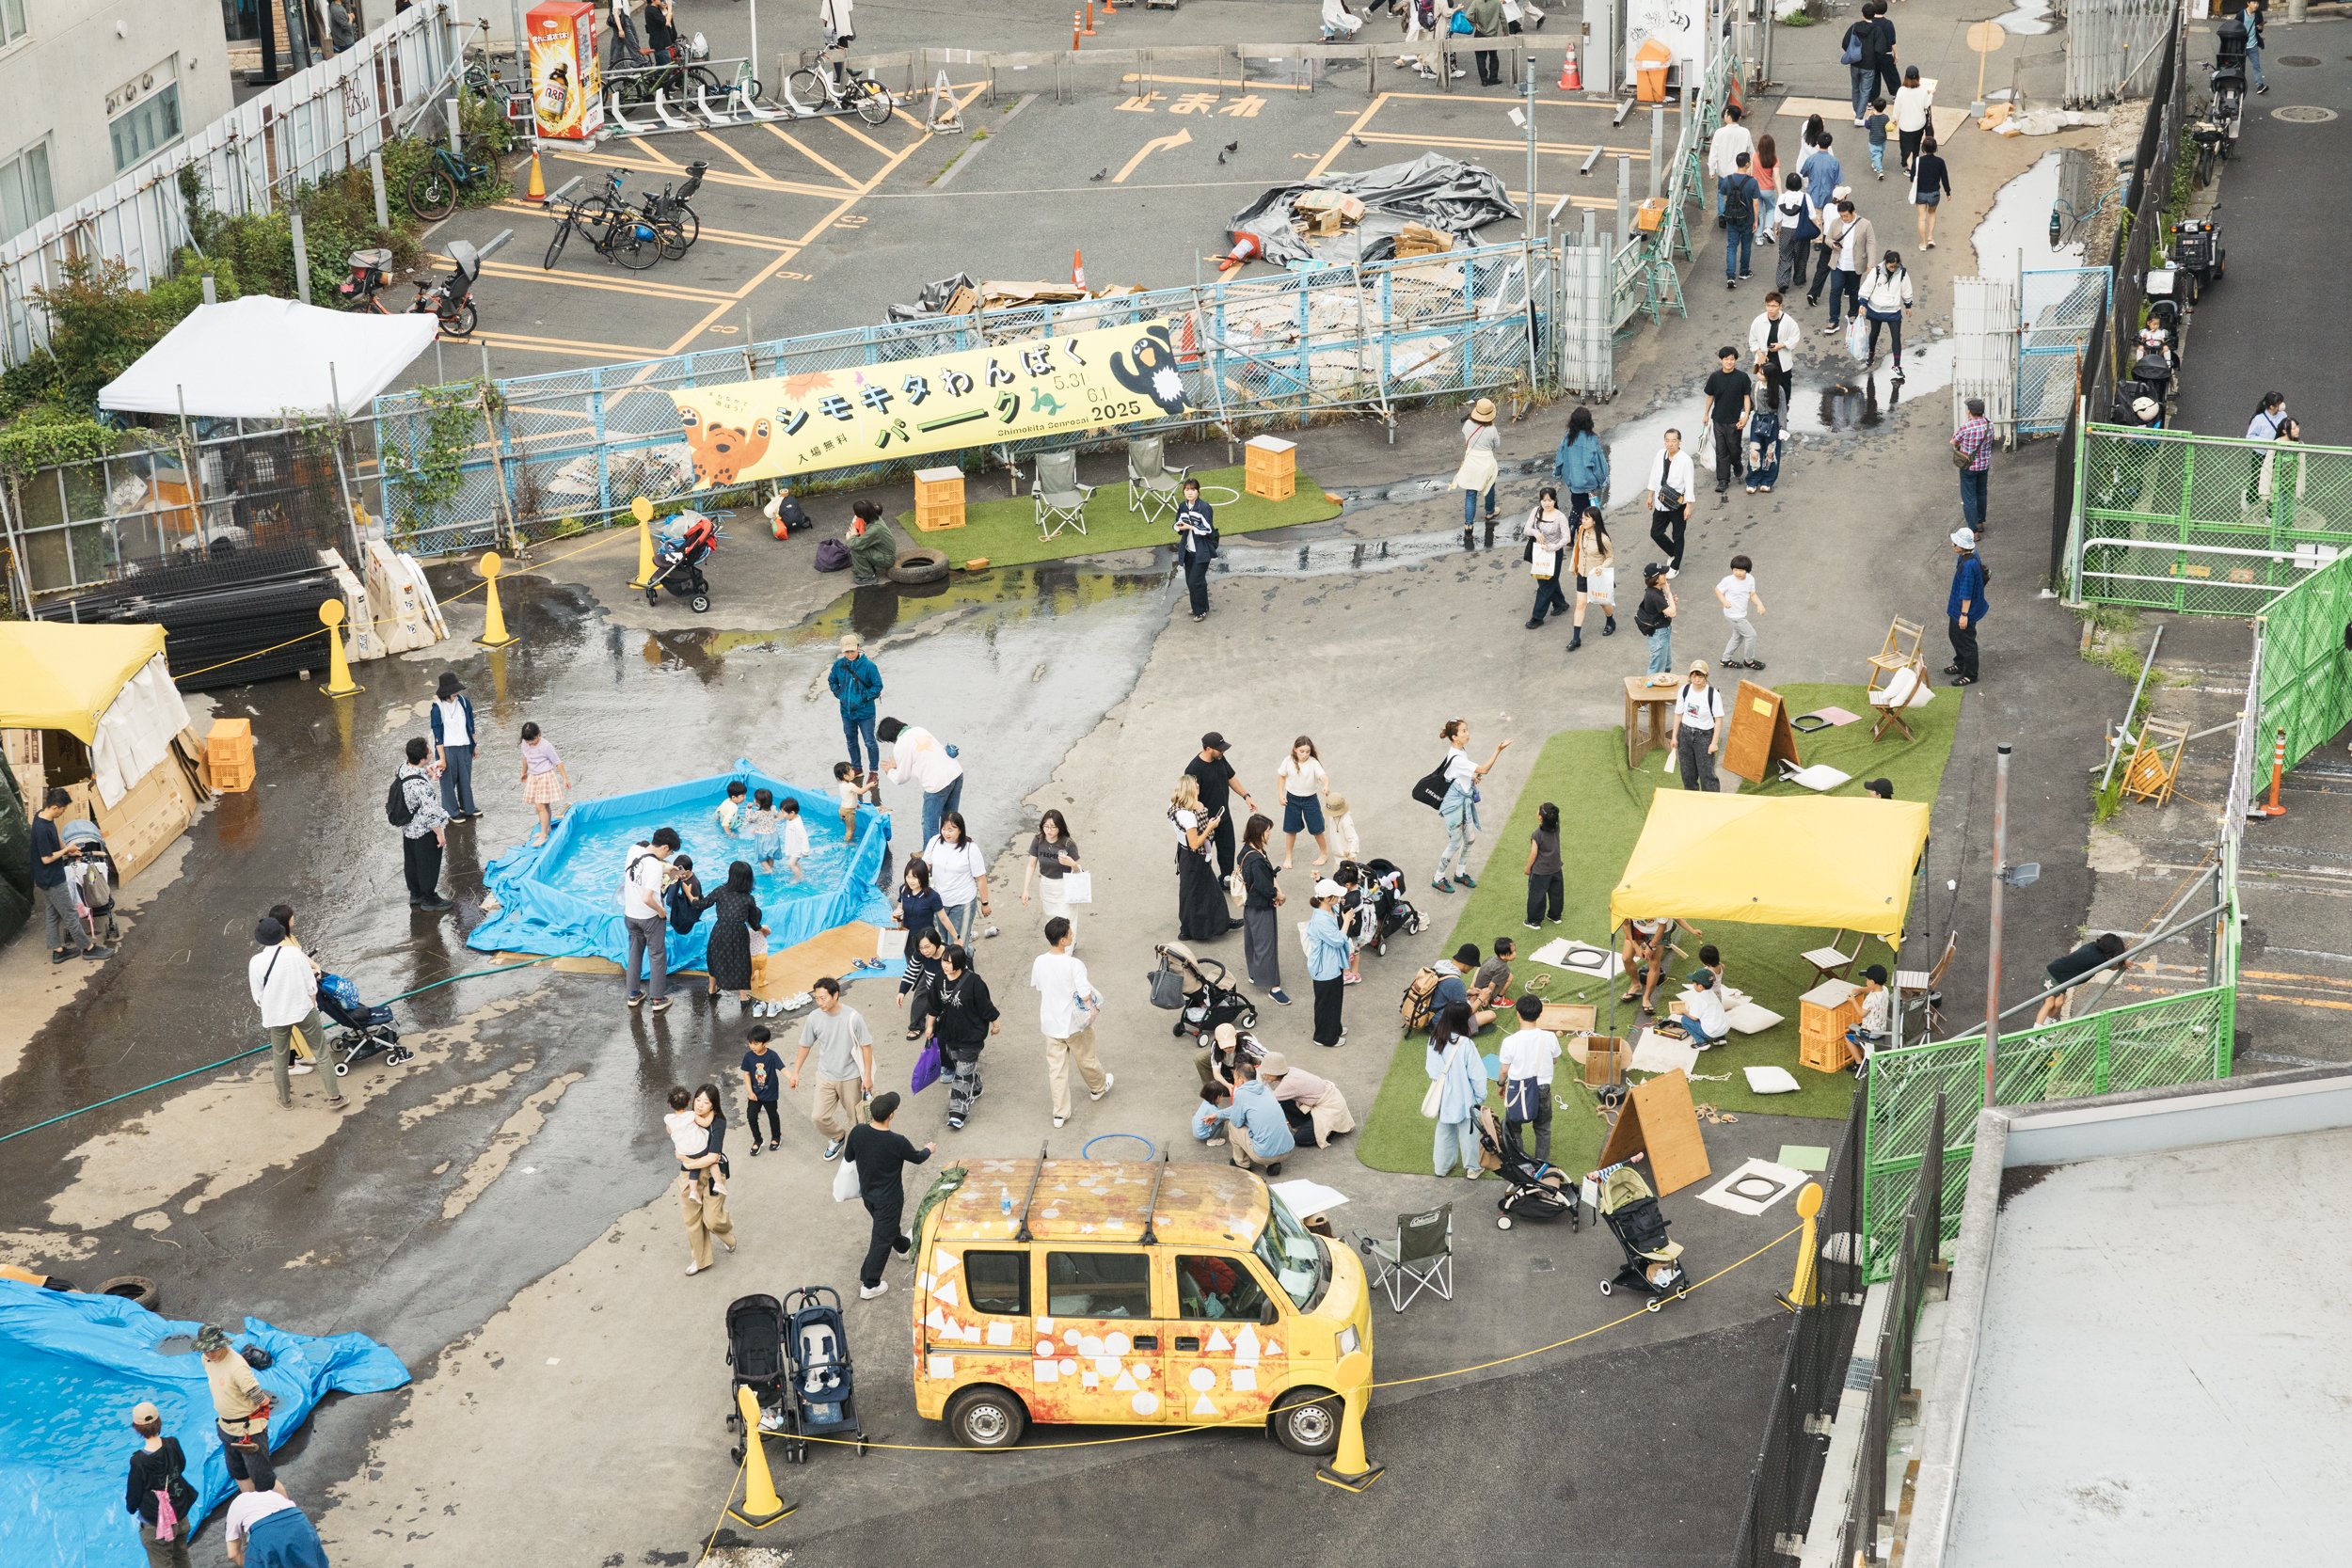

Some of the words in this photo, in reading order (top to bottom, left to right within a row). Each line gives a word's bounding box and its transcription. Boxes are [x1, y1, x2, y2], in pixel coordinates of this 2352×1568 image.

[776, 337, 1088, 437] シモキタわんぱく
[1087, 387, 1107, 403] 6.1
[874, 390, 1021, 450] パーク
[1091, 401, 1142, 421] 2025
[997, 425, 1045, 436] Shimokita
[798, 433, 848, 466] 入場無料
